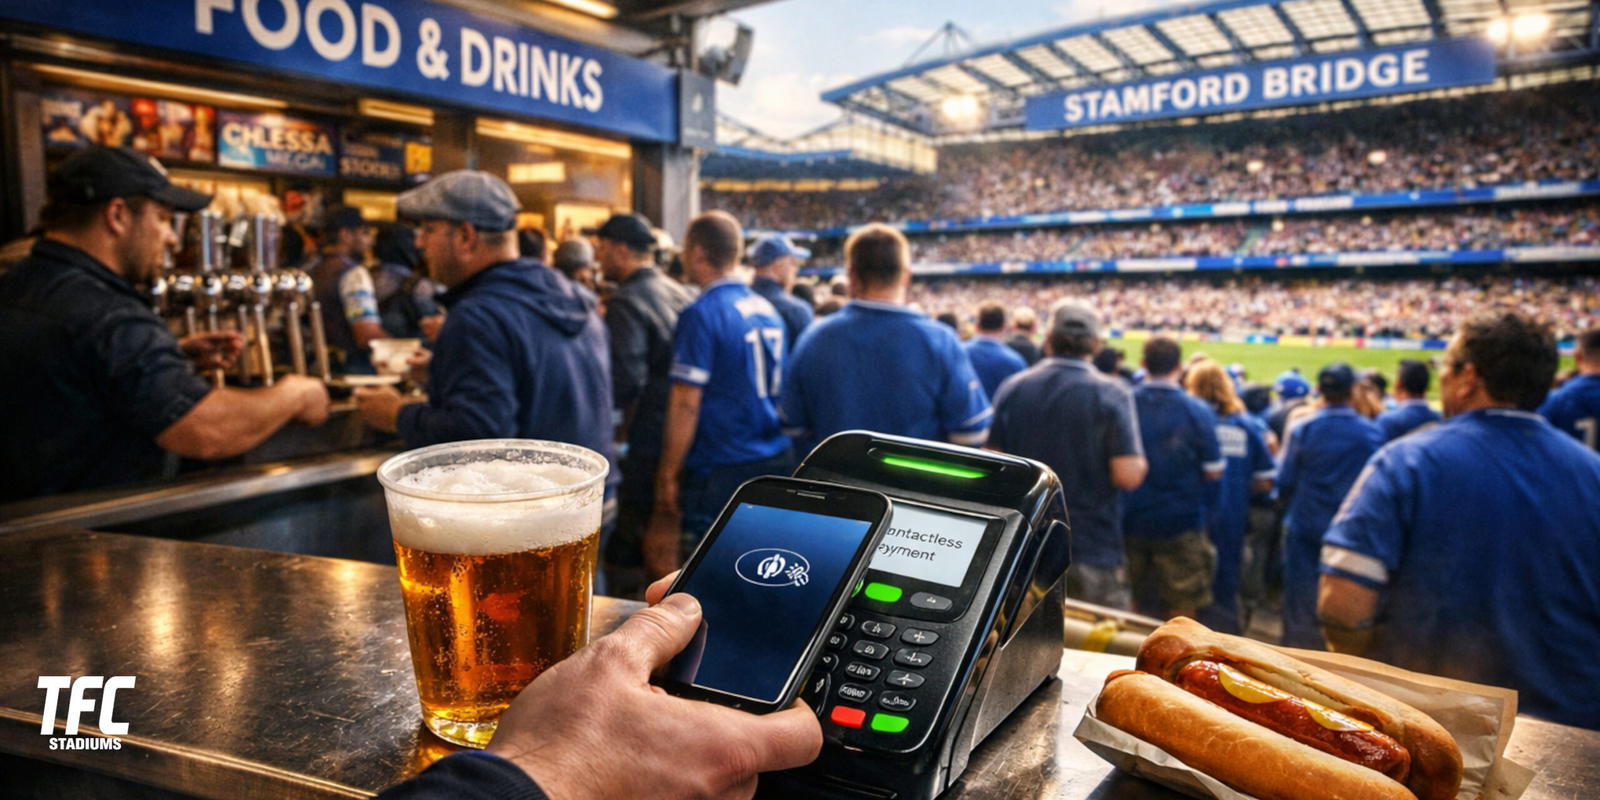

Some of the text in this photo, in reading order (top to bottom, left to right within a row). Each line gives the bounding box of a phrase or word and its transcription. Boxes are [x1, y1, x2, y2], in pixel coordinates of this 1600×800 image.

[416, 17, 450, 81] &
[460, 27, 604, 113] DRINKS
[1063, 49, 1430, 123] STAMFORD BRIDGE
[745, 327, 784, 400] 17
[886, 527, 964, 549] ontactless
